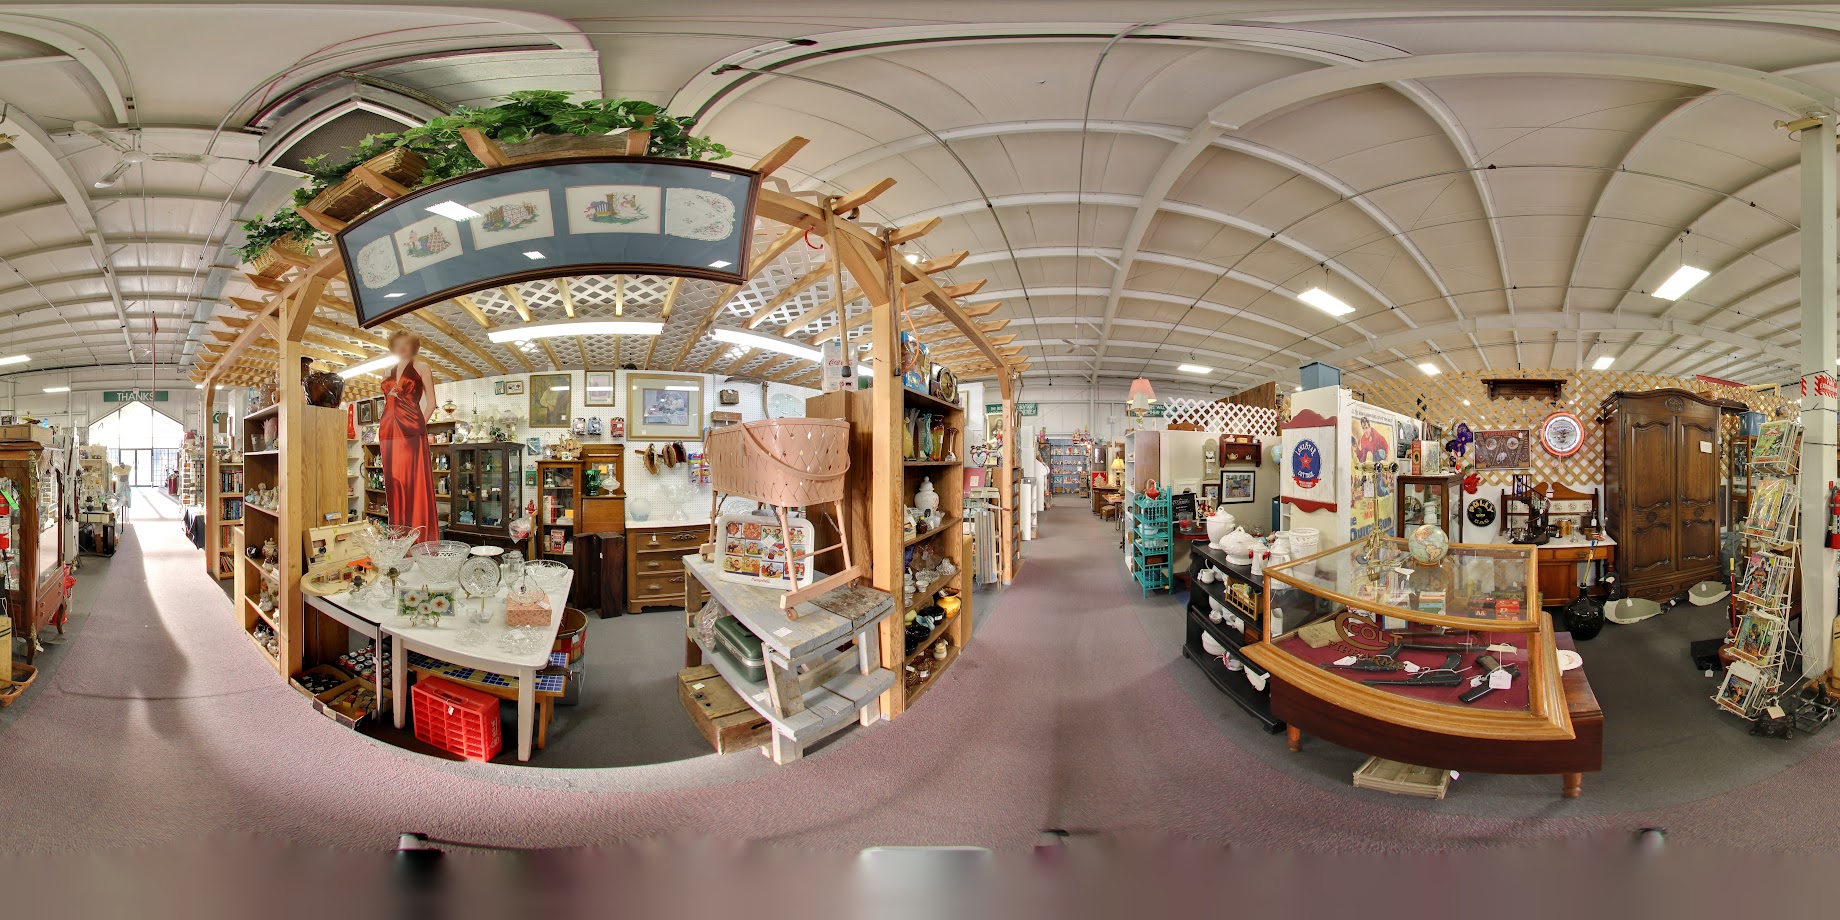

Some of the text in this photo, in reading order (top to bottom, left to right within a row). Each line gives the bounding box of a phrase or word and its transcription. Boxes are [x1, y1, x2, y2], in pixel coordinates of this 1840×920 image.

[117, 392, 154, 401] THANKS
[1469, 500, 1494, 513] POLLY
[1347, 622, 1403, 647] COLT
[1328, 640, 1407, 670] FIREARMS
